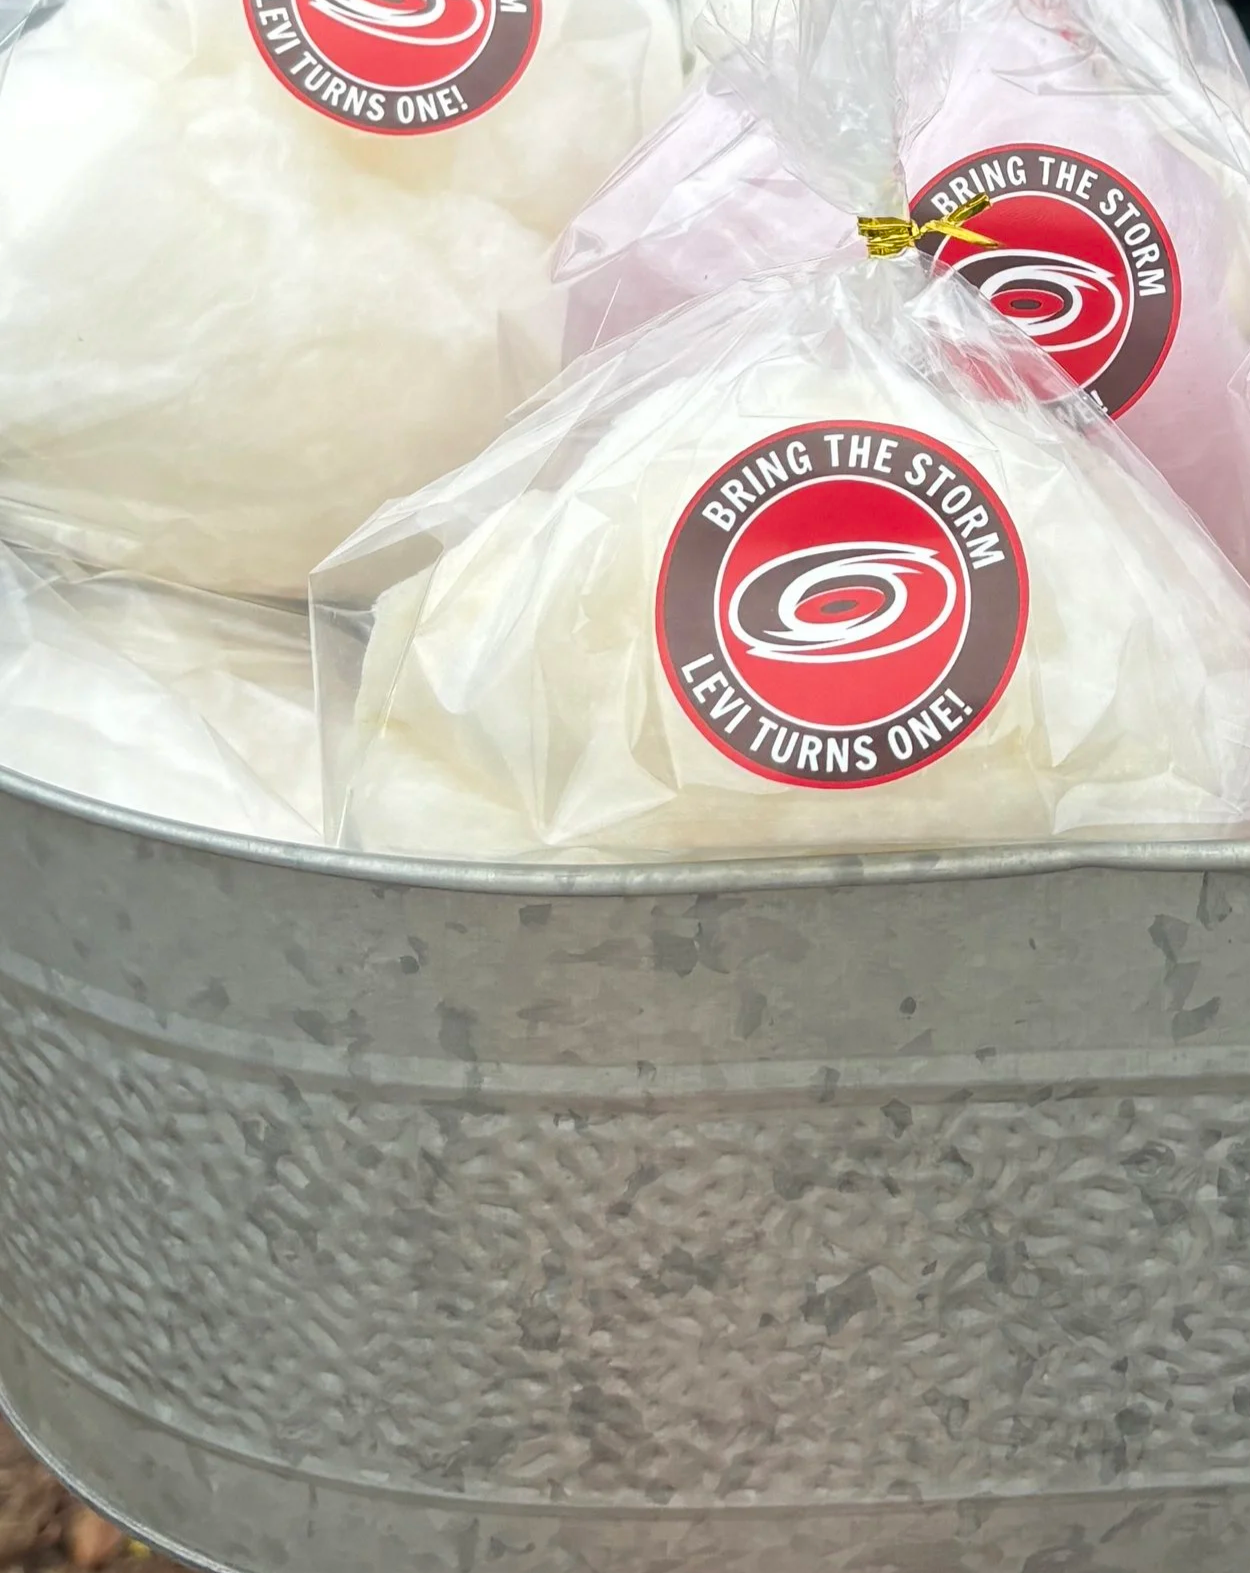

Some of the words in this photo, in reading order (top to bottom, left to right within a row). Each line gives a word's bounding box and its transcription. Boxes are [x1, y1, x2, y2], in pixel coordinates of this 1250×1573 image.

[290, 51, 385, 121] TURNS
[397, 85, 468, 124] ONE!
[931, 156, 1026, 217] BRING
[1038, 156, 1098, 200] THE
[1100, 188, 1166, 296] STORM
[702, 441, 812, 532] BRING
[824, 434, 898, 473] THE
[905, 452, 1005, 570] STORM
[681, 653, 751, 734] LEVI
[750, 717, 878, 773] TURNS
[887, 688, 973, 761] ONE!
